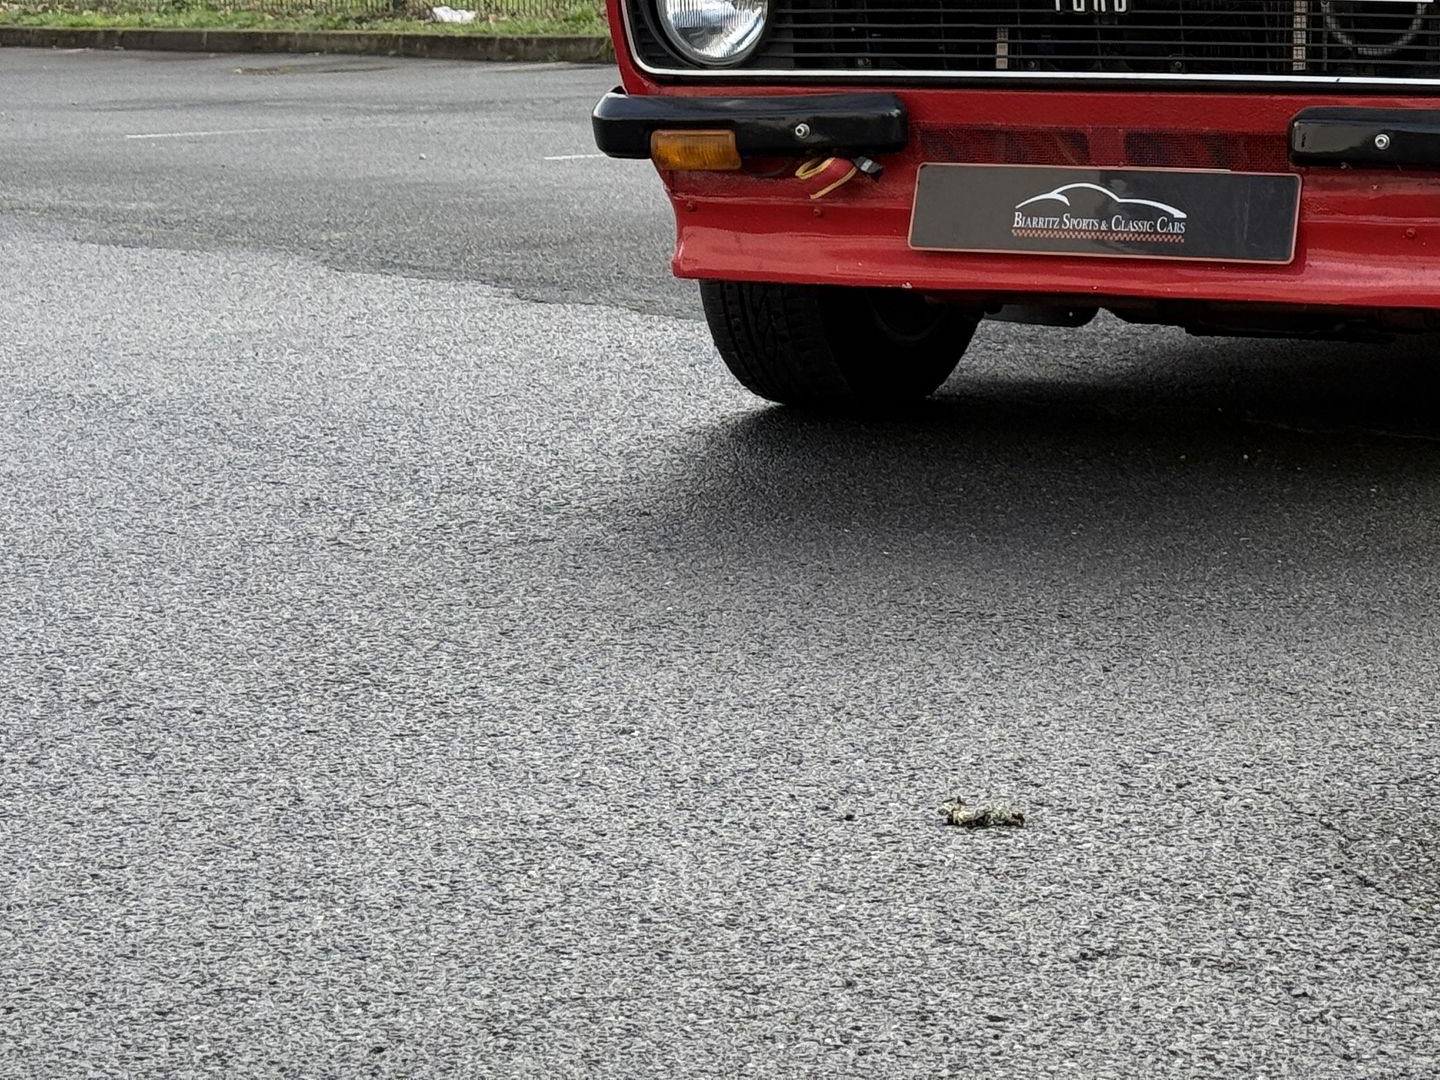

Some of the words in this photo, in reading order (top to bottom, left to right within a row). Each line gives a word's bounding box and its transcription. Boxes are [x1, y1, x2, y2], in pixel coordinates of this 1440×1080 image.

[1013, 211, 1060, 229] BIARRITZ
[1061, 212, 1100, 230] SPORTS
[1100, 220, 1109, 231] &
[1111, 214, 1154, 233] CLASSIC
[1156, 216, 1187, 234] CARS
